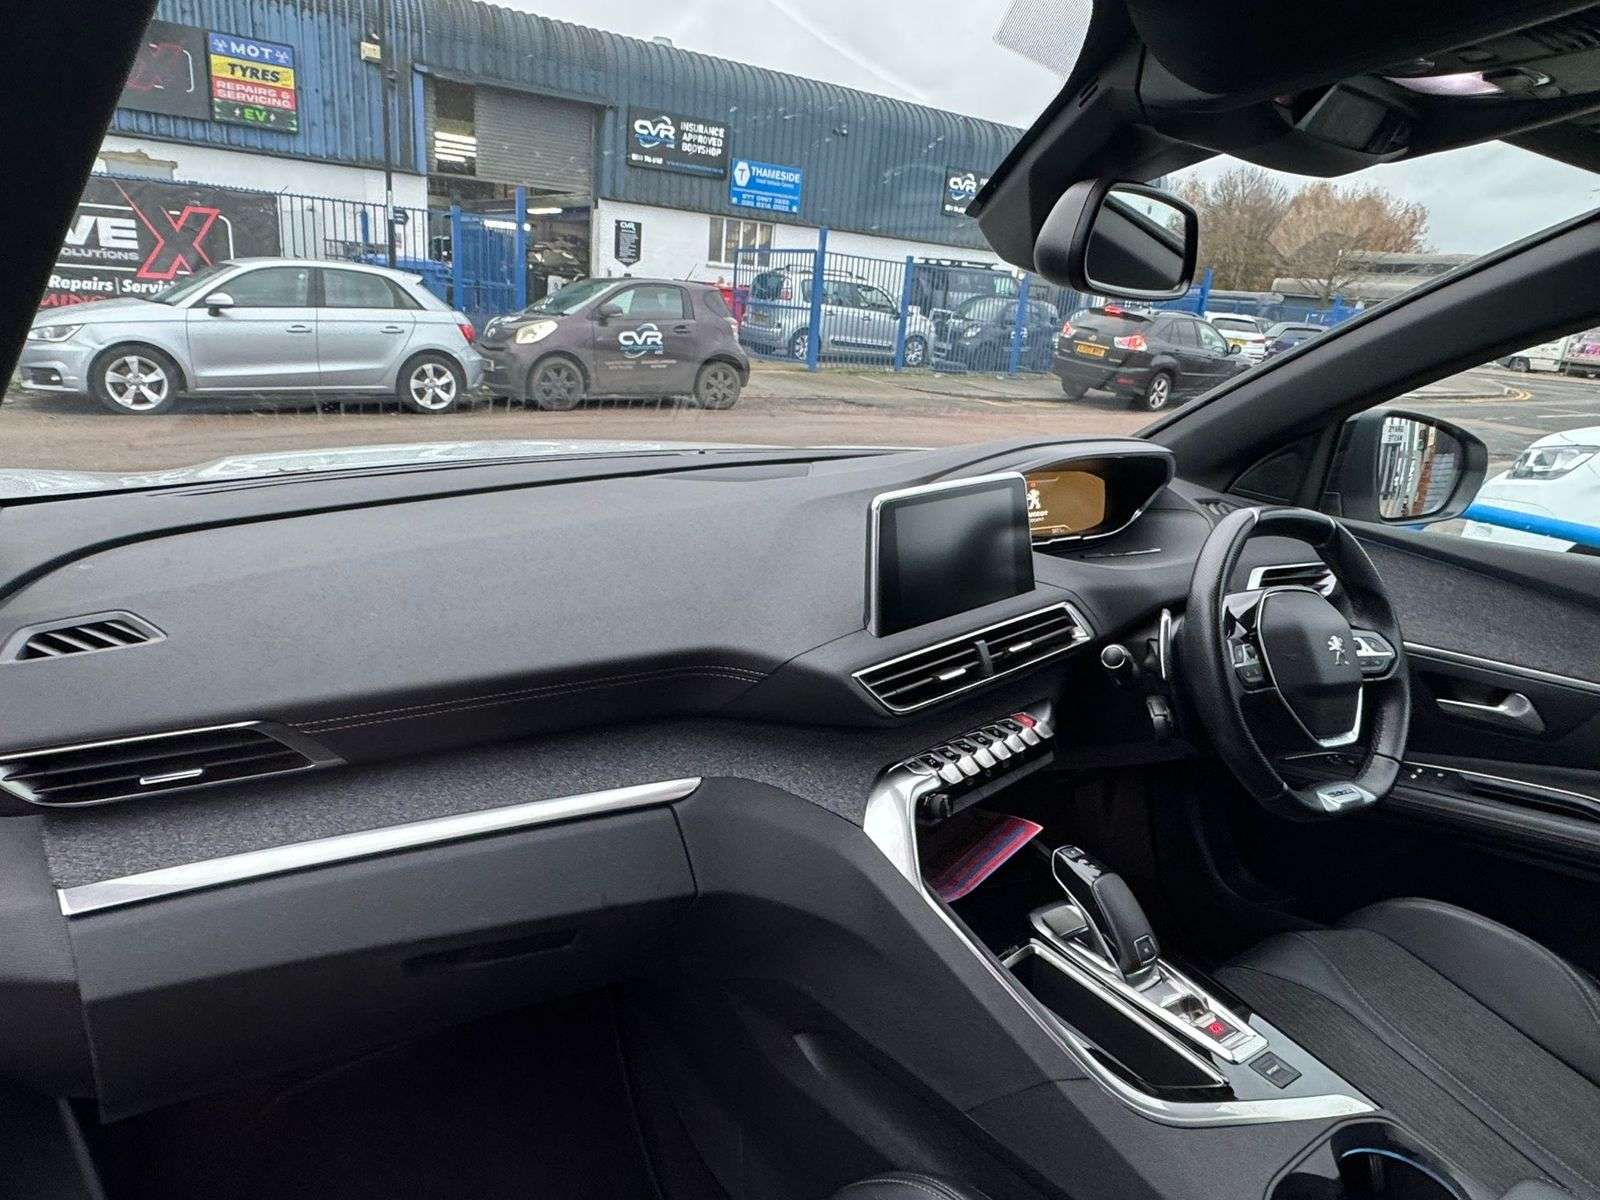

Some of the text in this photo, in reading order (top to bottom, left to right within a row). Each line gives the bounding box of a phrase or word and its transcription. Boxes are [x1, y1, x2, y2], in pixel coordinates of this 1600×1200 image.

[230, 41, 273, 59] MOT
[227, 62, 281, 83] TYRES
[216, 81, 277, 97] REPAIRS
[217, 89, 291, 107] SERVICING
[243, 107, 268, 122] EV
[633, 119, 676, 140] CVR
[680, 121, 725, 138] INSURANCE
[681, 132, 724, 148] APPROVED
[681, 141, 722, 157] BODYSHOP
[751, 166, 800, 184] THAMESIDE
[949, 176, 977, 193] CVR
[48, 274, 114, 292] Repairs
[618, 330, 663, 346] CVR
